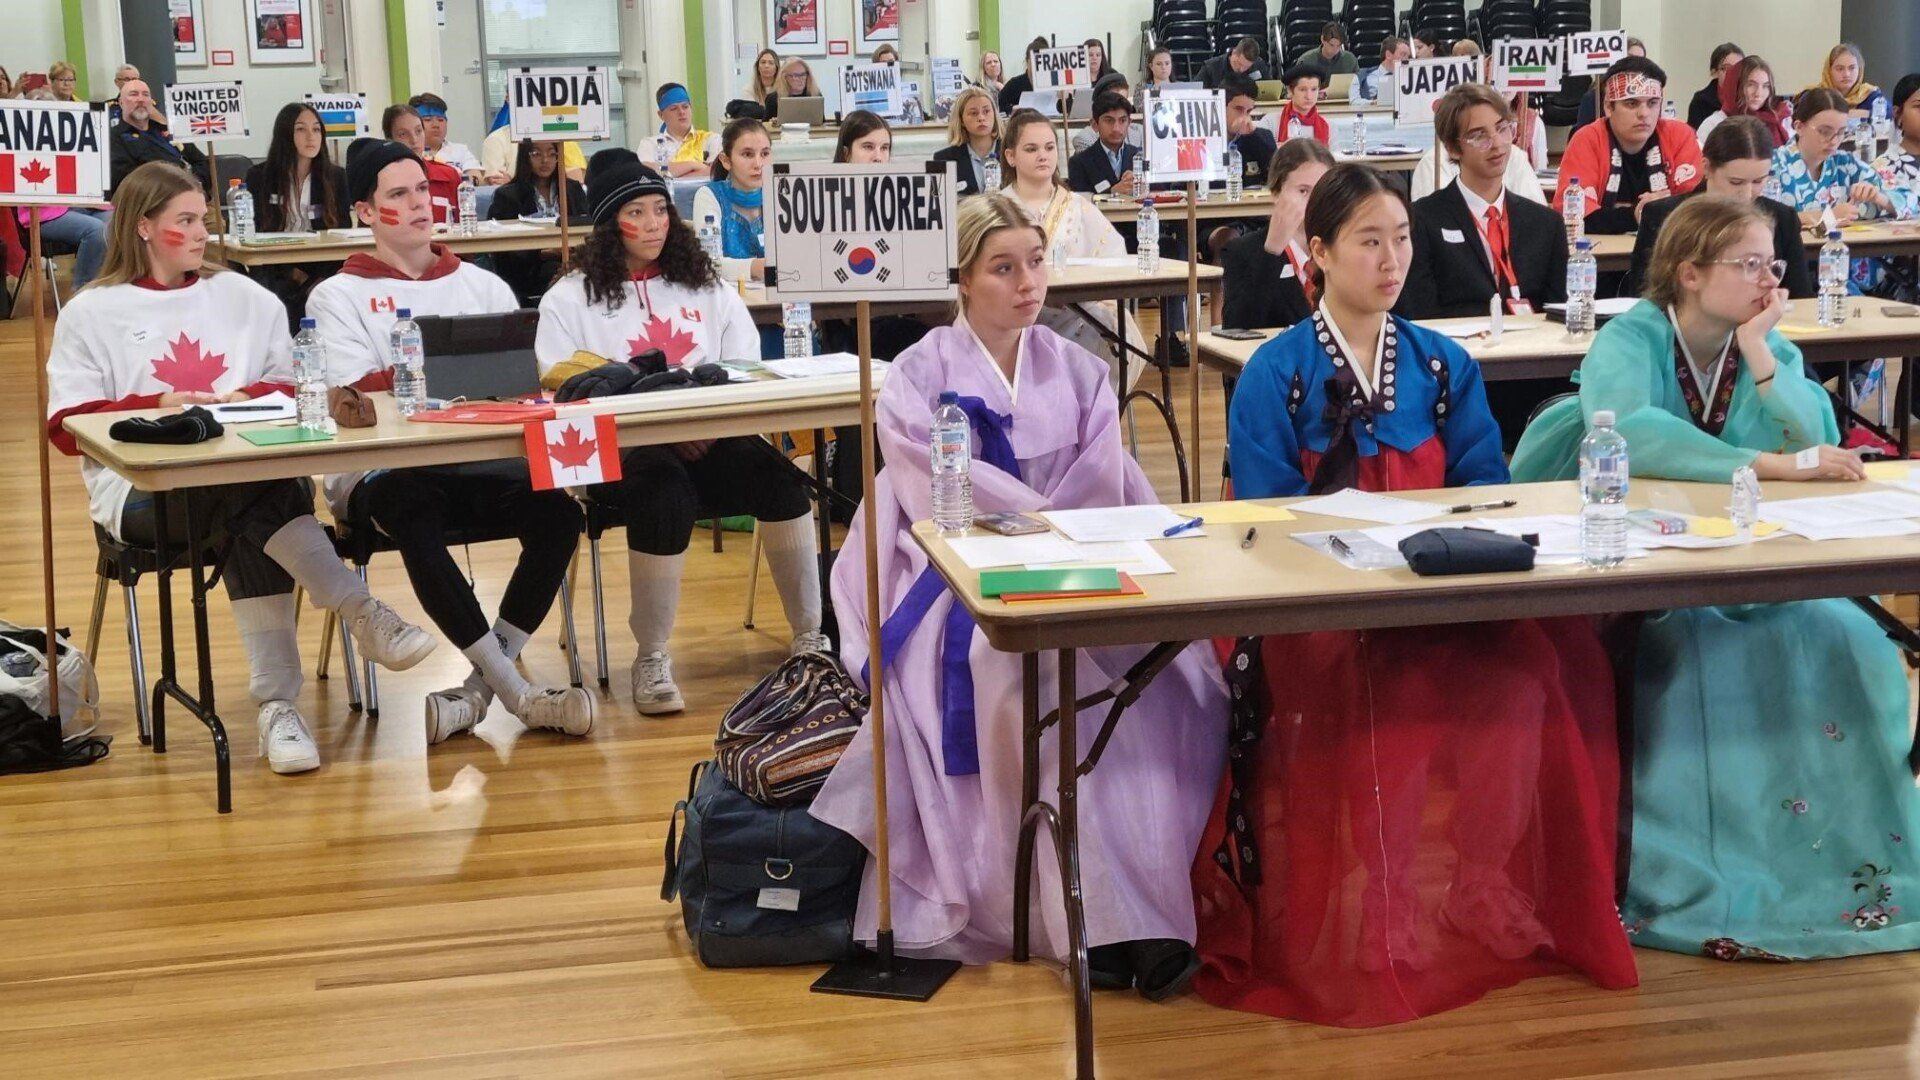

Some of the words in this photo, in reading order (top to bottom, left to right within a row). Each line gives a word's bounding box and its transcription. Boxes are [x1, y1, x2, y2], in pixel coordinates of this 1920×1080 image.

[1499, 45, 1557, 67] IRAN
[1572, 35, 1623, 54] IRAQ
[1035, 51, 1086, 71] FRANCE
[845, 69, 895, 93] BOTSWANA
[1401, 62, 1477, 95] JAPAN
[172, 88, 239, 102] UNITED
[515, 76, 602, 107] INDIA
[174, 100, 240, 116] KINGDOM
[1152, 101, 1222, 139] CHINA
[0, 109, 98, 152] ANADA
[778, 177, 856, 234] SOUTH
[864, 175, 943, 232] KOREA
